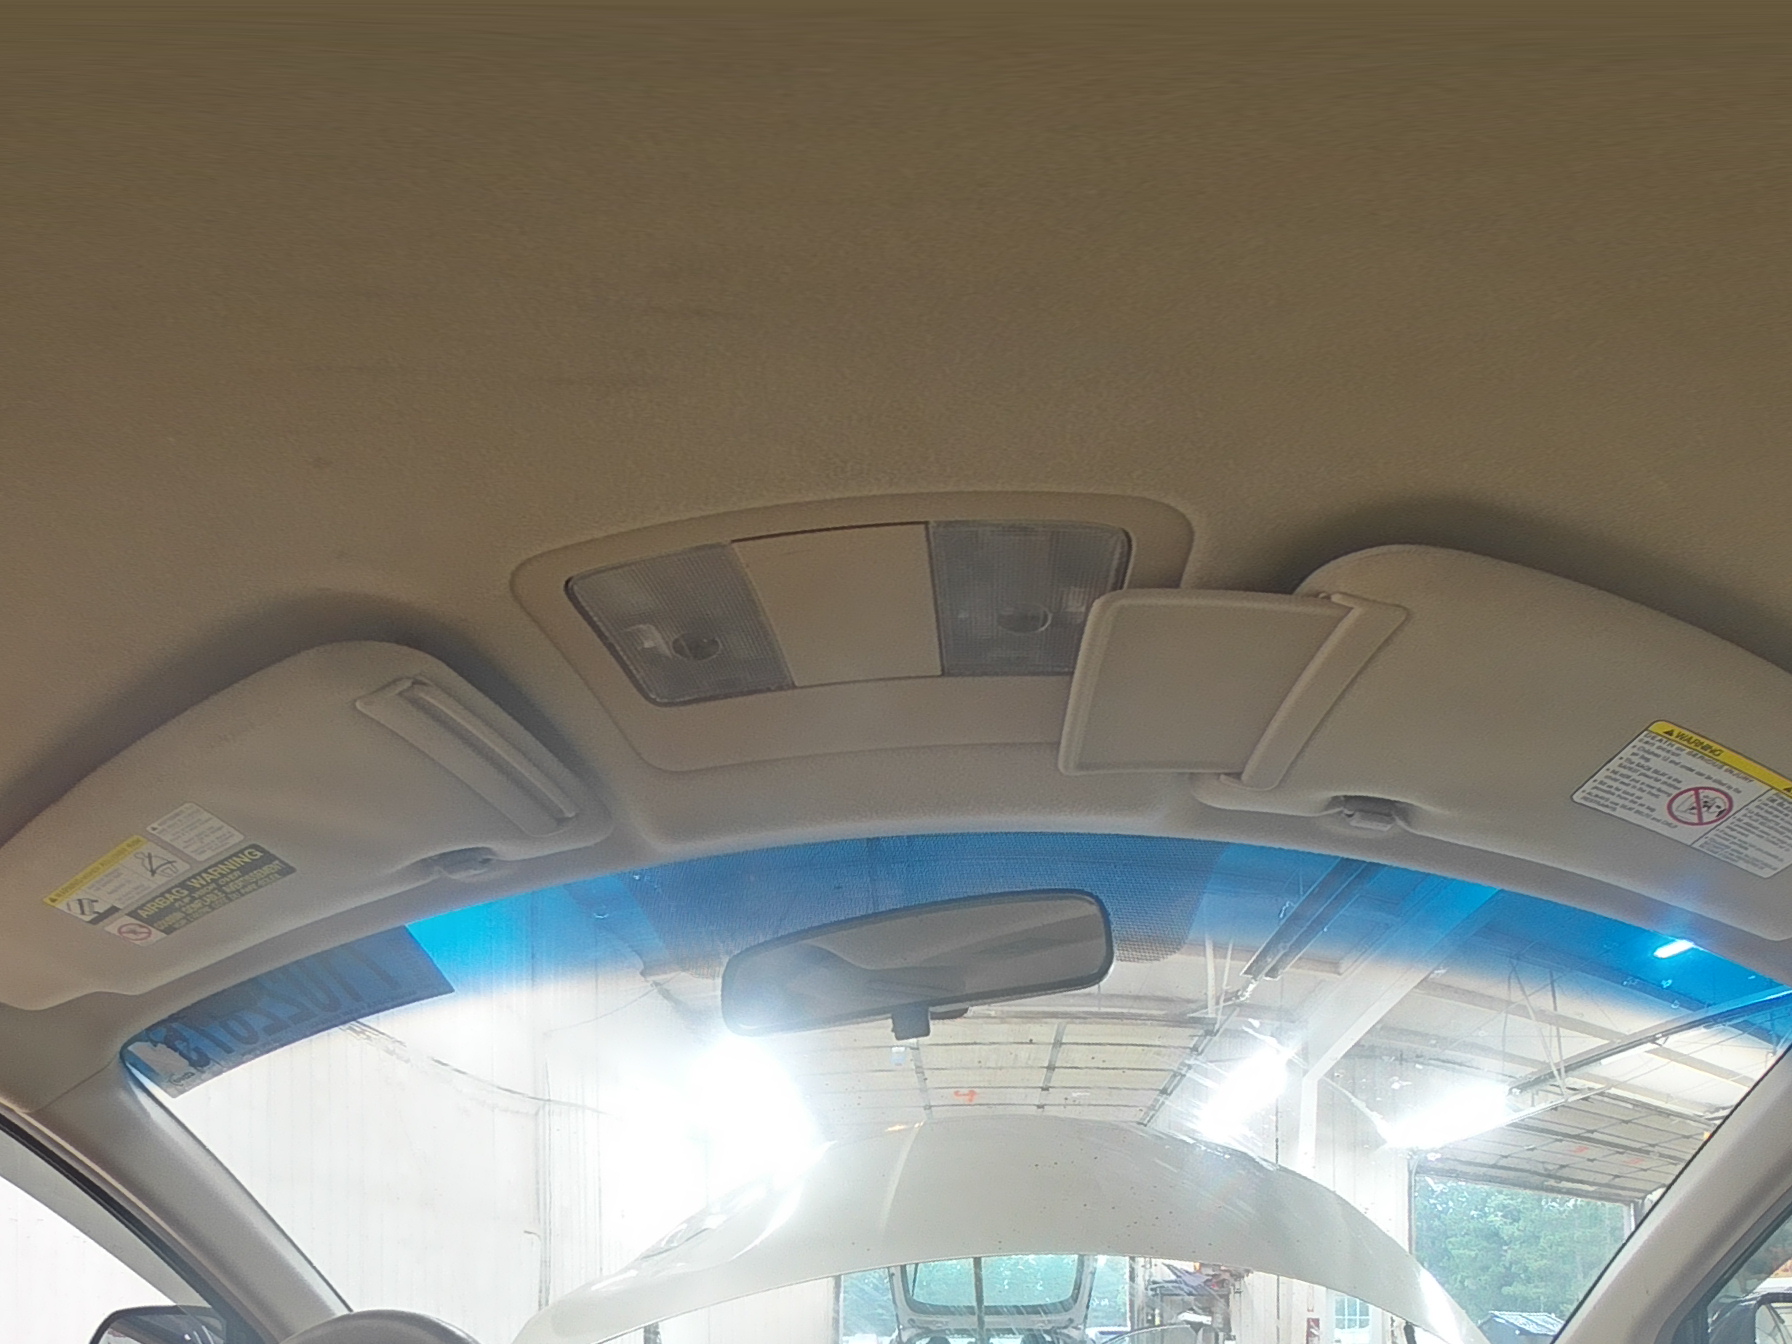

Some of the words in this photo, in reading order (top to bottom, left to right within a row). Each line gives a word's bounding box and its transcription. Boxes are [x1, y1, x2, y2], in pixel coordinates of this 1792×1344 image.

[1672, 730, 1724, 757] WARNING
[133, 885, 190, 918] AIRBAG
[185, 846, 264, 889] WARNING
